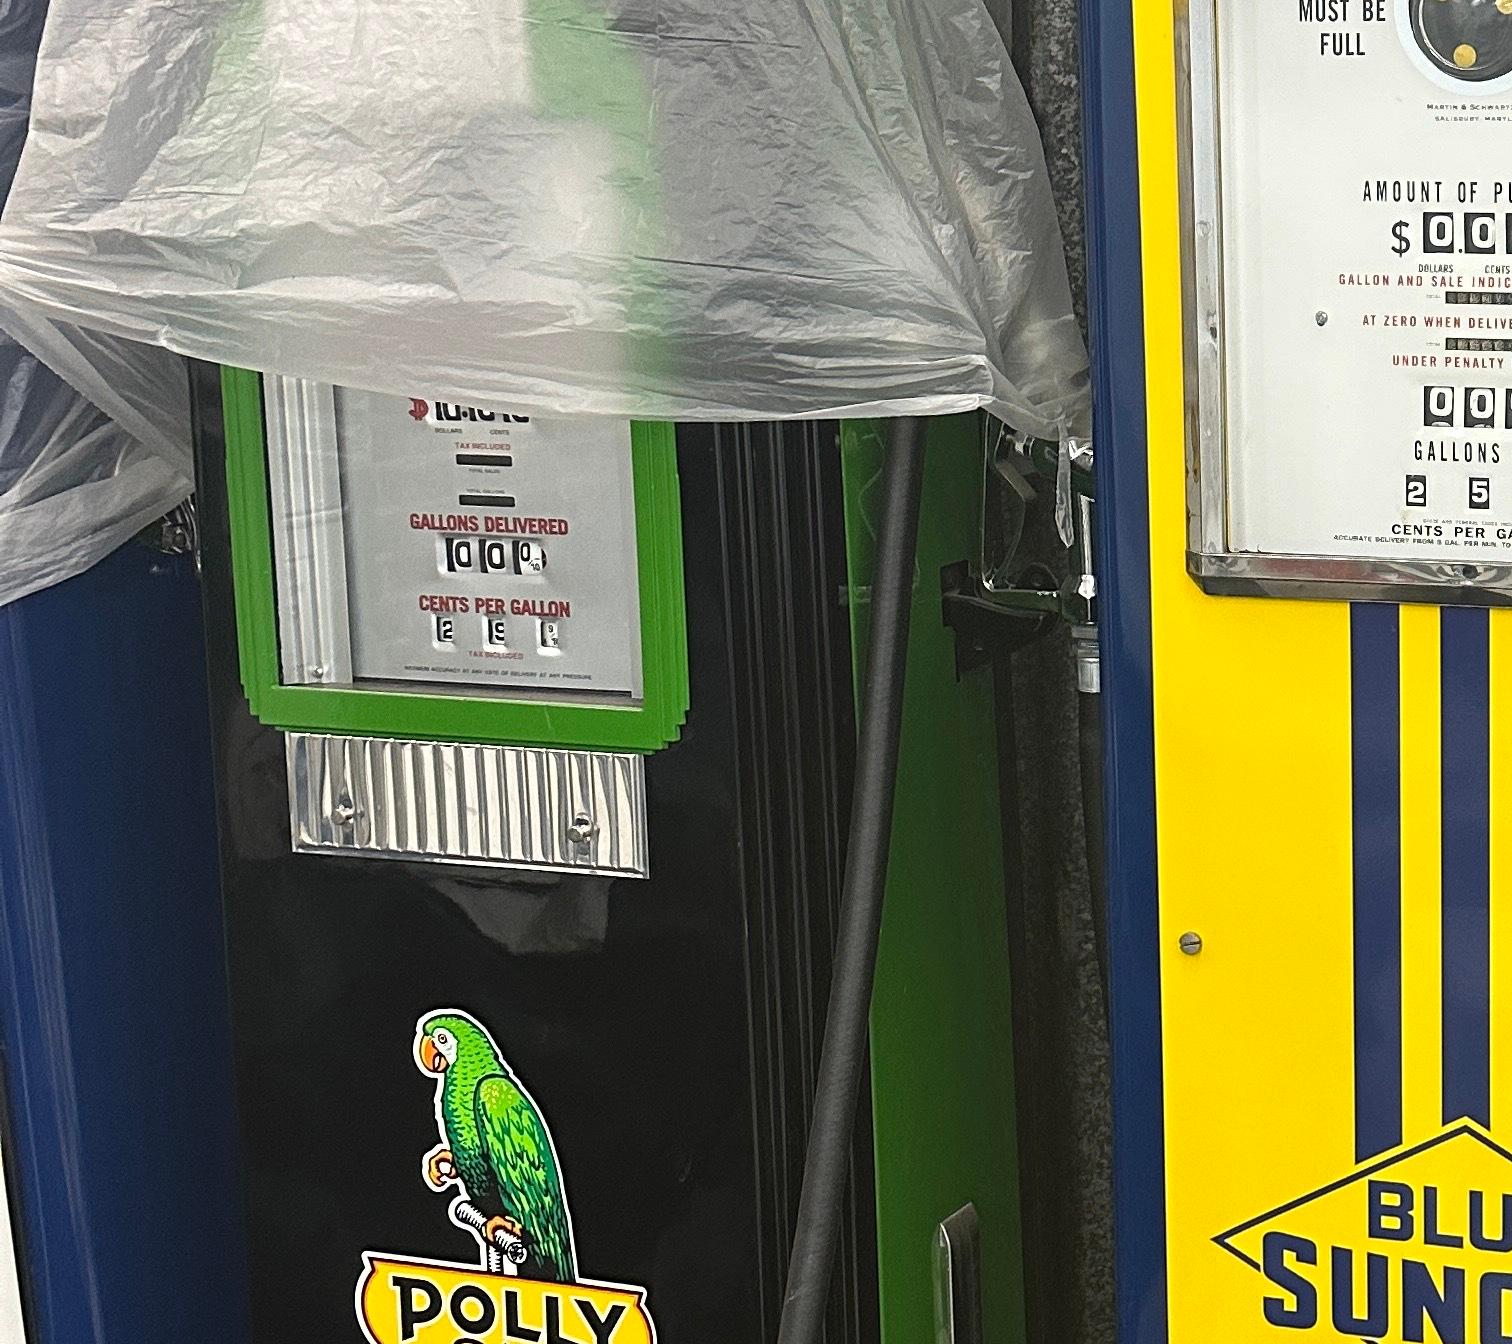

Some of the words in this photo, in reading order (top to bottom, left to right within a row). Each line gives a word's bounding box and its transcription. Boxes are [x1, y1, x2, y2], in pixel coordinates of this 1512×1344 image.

[1299, 0, 1349, 22] MUST
[1320, 32, 1366, 56] FULL
[1363, 181, 1443, 204] AMOUNT
[1458, 182, 1477, 203] OF
[1419, 264, 1454, 273] DOLLARS
[1485, 265, 1510, 274] CENTS
[1339, 274, 1390, 286] GALLON
[1398, 275, 1423, 287] AND
[1431, 276, 1463, 287] SALE
[1363, 315, 1376, 326] AT
[1384, 315, 1417, 327] ZERO
[1424, 316, 1462, 328] WHEN
[1393, 355, 1437, 368] UNDER
[1445, 356, 1504, 369] PENALTY
[1414, 440, 1500, 463] GALLONS
[1408, 481, 1424, 504] 2
[1471, 481, 1488, 503] 5
[410, 513, 479, 531] GALLONS
[484, 516, 568, 535] DELIVERED
[1392, 524, 1443, 536] CENTS
[1454, 527, 1485, 538] PER
[419, 595, 469, 613] CENTS
[475, 597, 506, 615] PER
[511, 599, 570, 617] GALLON
[442, 621, 452, 639] 2
